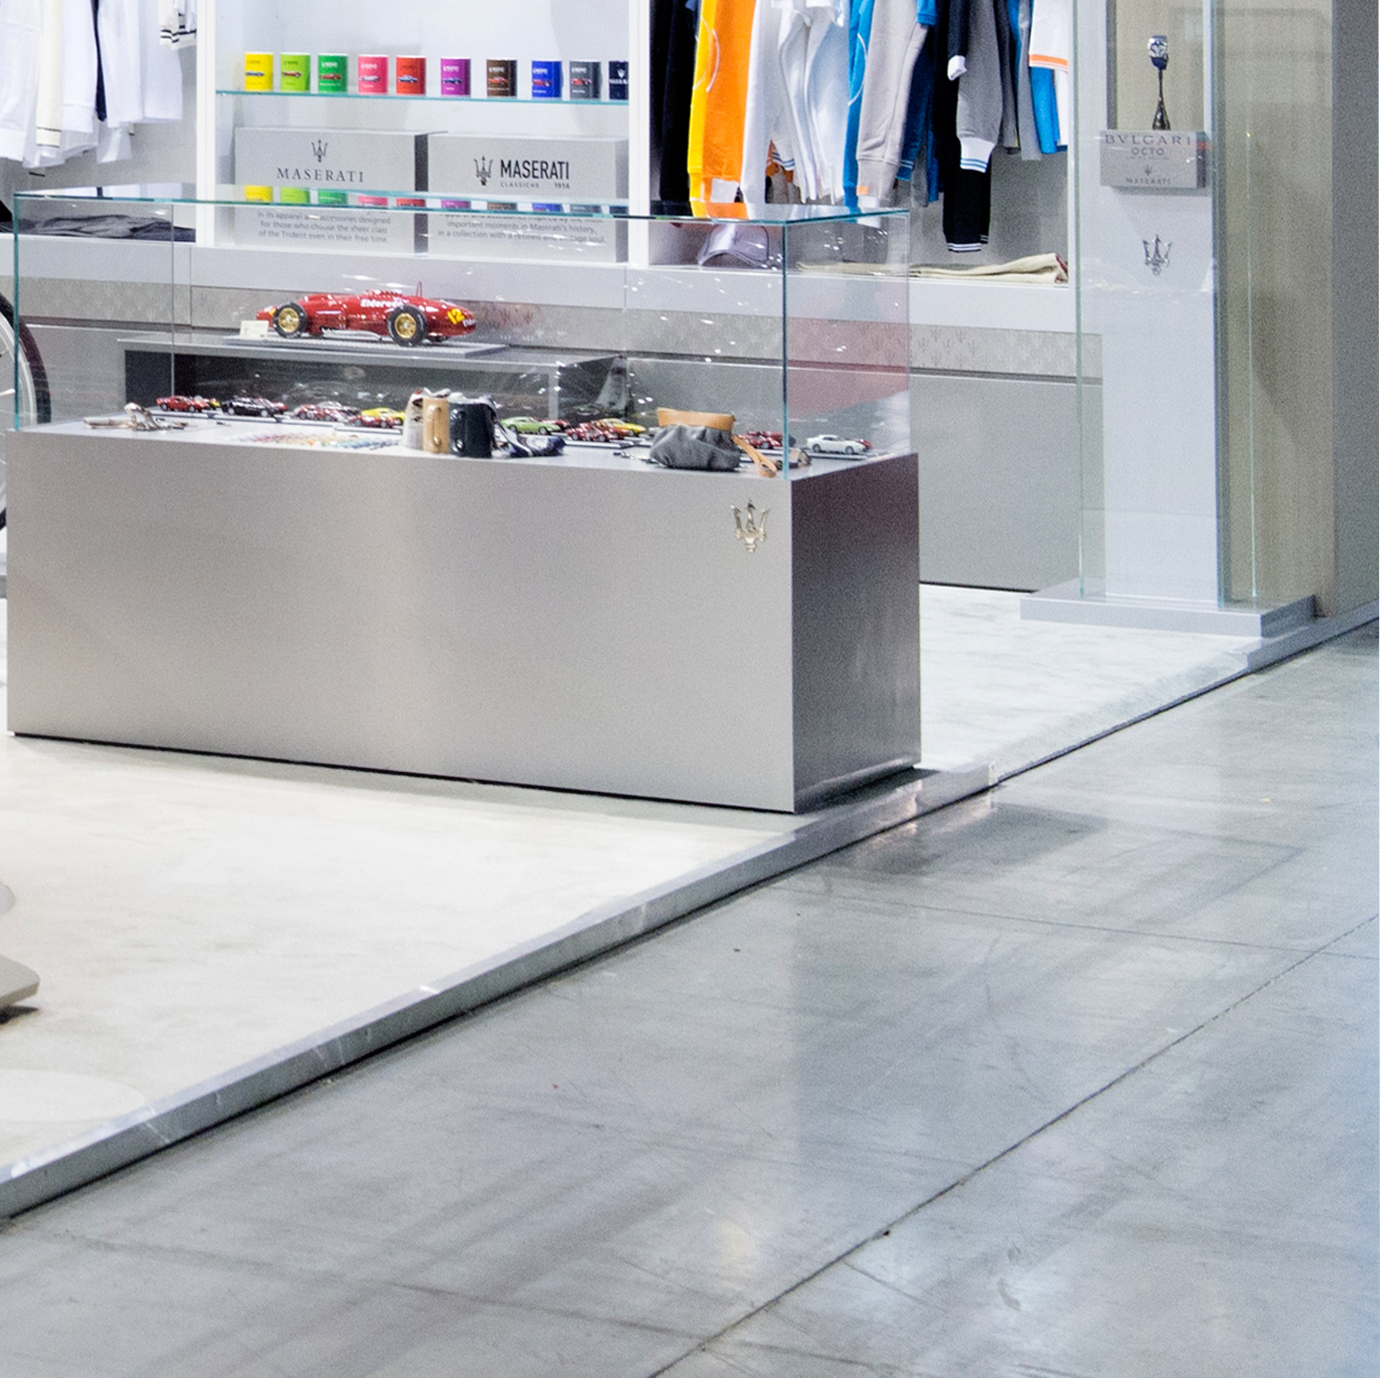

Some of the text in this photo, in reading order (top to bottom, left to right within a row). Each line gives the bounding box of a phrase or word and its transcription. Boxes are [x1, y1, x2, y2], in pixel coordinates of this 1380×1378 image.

[1105, 134, 1192, 146] BVLGARI
[1131, 147, 1165, 156] OCTO
[276, 167, 364, 183] MASERATI
[501, 159, 570, 180] MASERATI
[499, 180, 540, 189] CLASSICHE
[1125, 177, 1172, 185] MASERATI
[447, 307, 465, 325] 12
